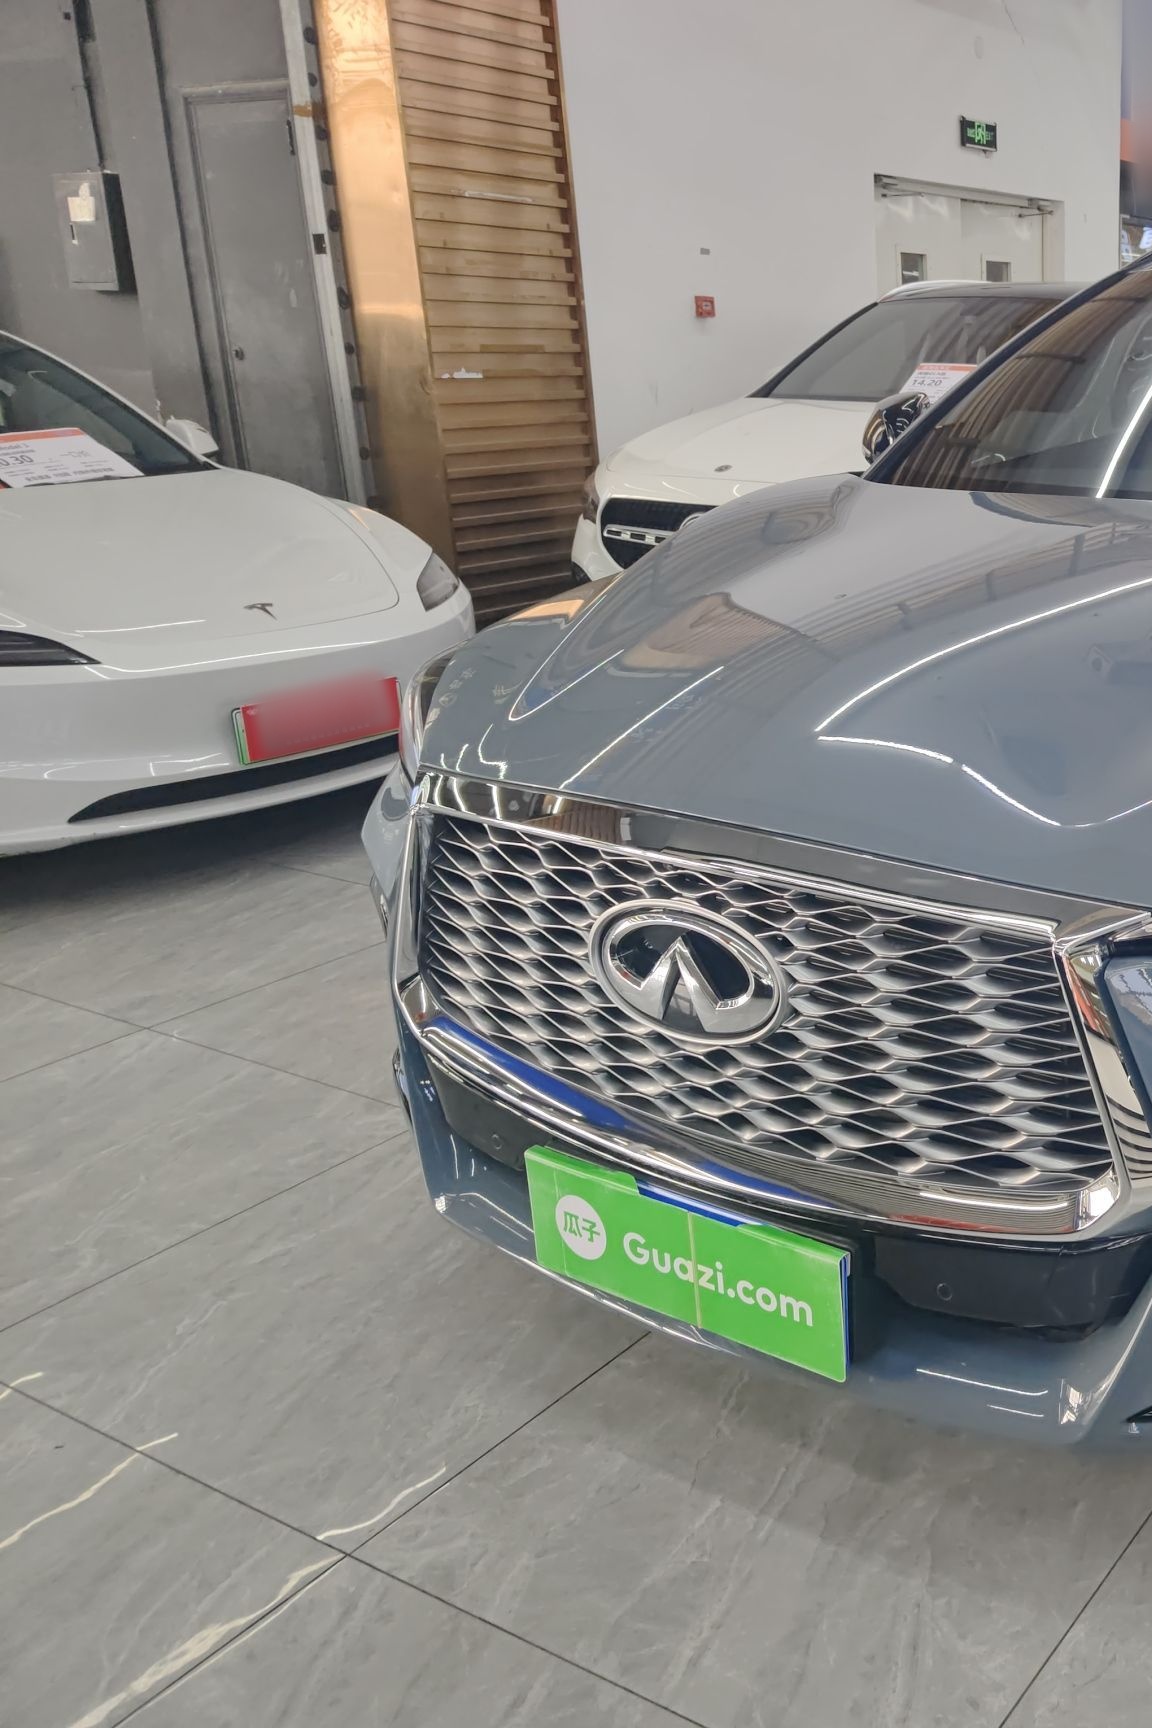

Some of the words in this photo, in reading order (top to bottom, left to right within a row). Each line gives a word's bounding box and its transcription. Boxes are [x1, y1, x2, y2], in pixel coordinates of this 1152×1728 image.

[911, 379, 942, 387] 14.20
[563, 1210, 602, 1243] 瓜子
[622, 1231, 814, 1328] Guazi.com
